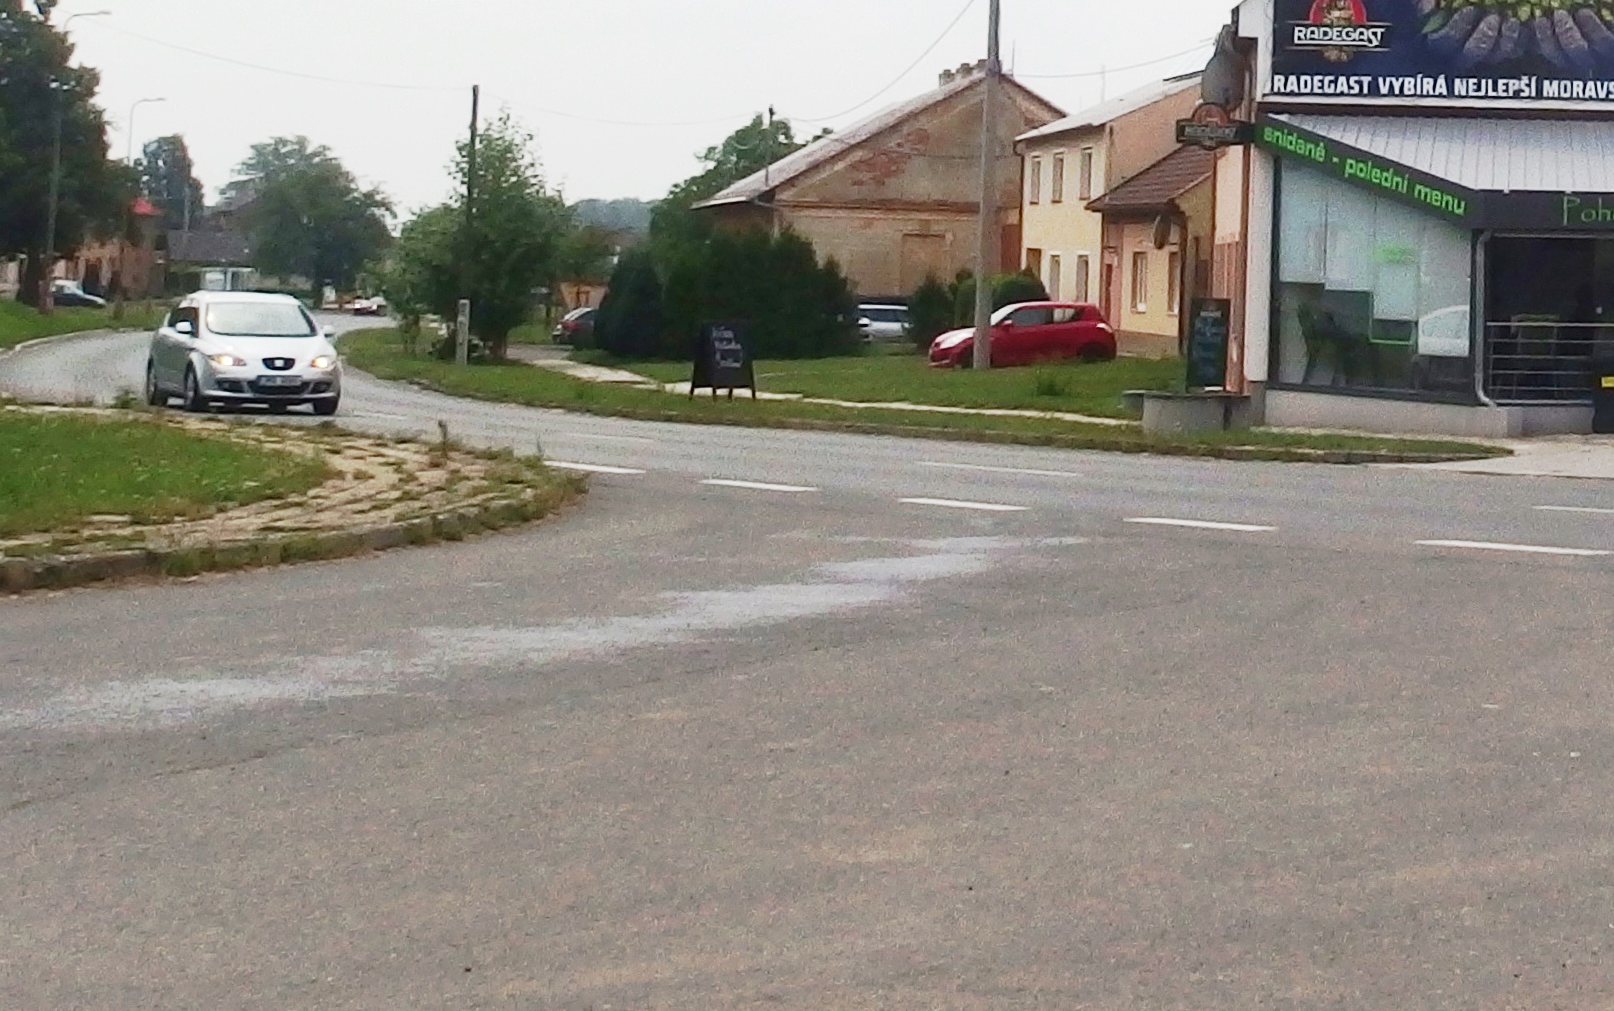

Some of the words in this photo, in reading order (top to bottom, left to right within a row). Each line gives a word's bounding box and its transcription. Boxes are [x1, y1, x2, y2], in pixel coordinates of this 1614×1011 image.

[1294, 26, 1386, 47] RADEGAST
[1273, 74, 1372, 95] RADEGAST
[1378, 73, 1448, 96] VYBÍRÁ
[1454, 75, 1538, 97] NEJLEPŠÍ
[1414, 183, 1466, 216] menu
